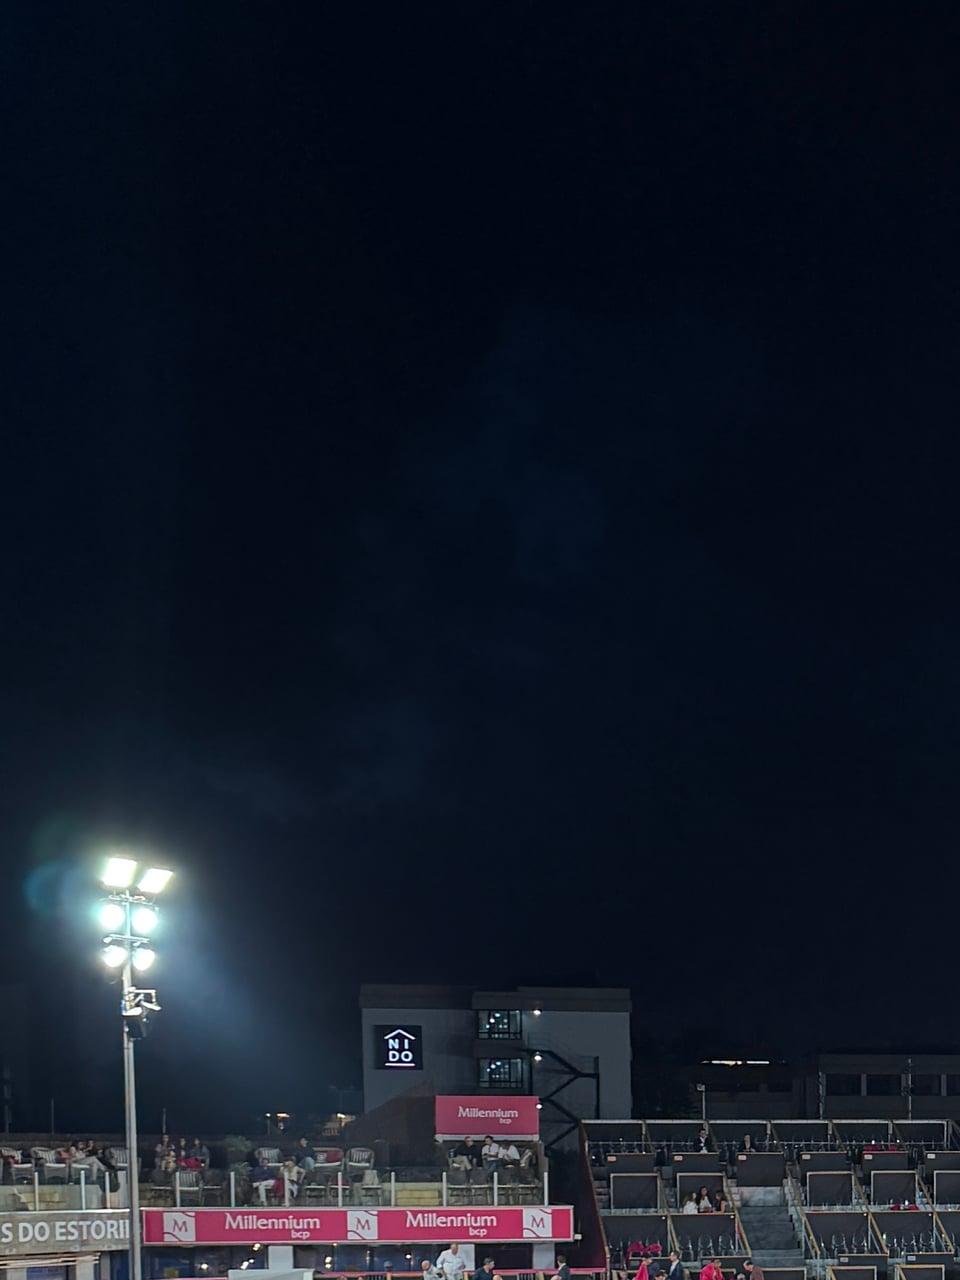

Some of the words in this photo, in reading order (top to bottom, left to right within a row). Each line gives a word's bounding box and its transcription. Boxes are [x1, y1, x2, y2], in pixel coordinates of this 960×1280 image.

[388, 1051, 413, 1062] DO
[458, 1106, 518, 1118] Millennium
[225, 1213, 320, 1230] Millennium
[405, 1210, 497, 1228] Millennium
[18, 1221, 50, 1242] DO
[291, 1229, 310, 1240] bcp
[469, 1226, 487, 1238] bcp
